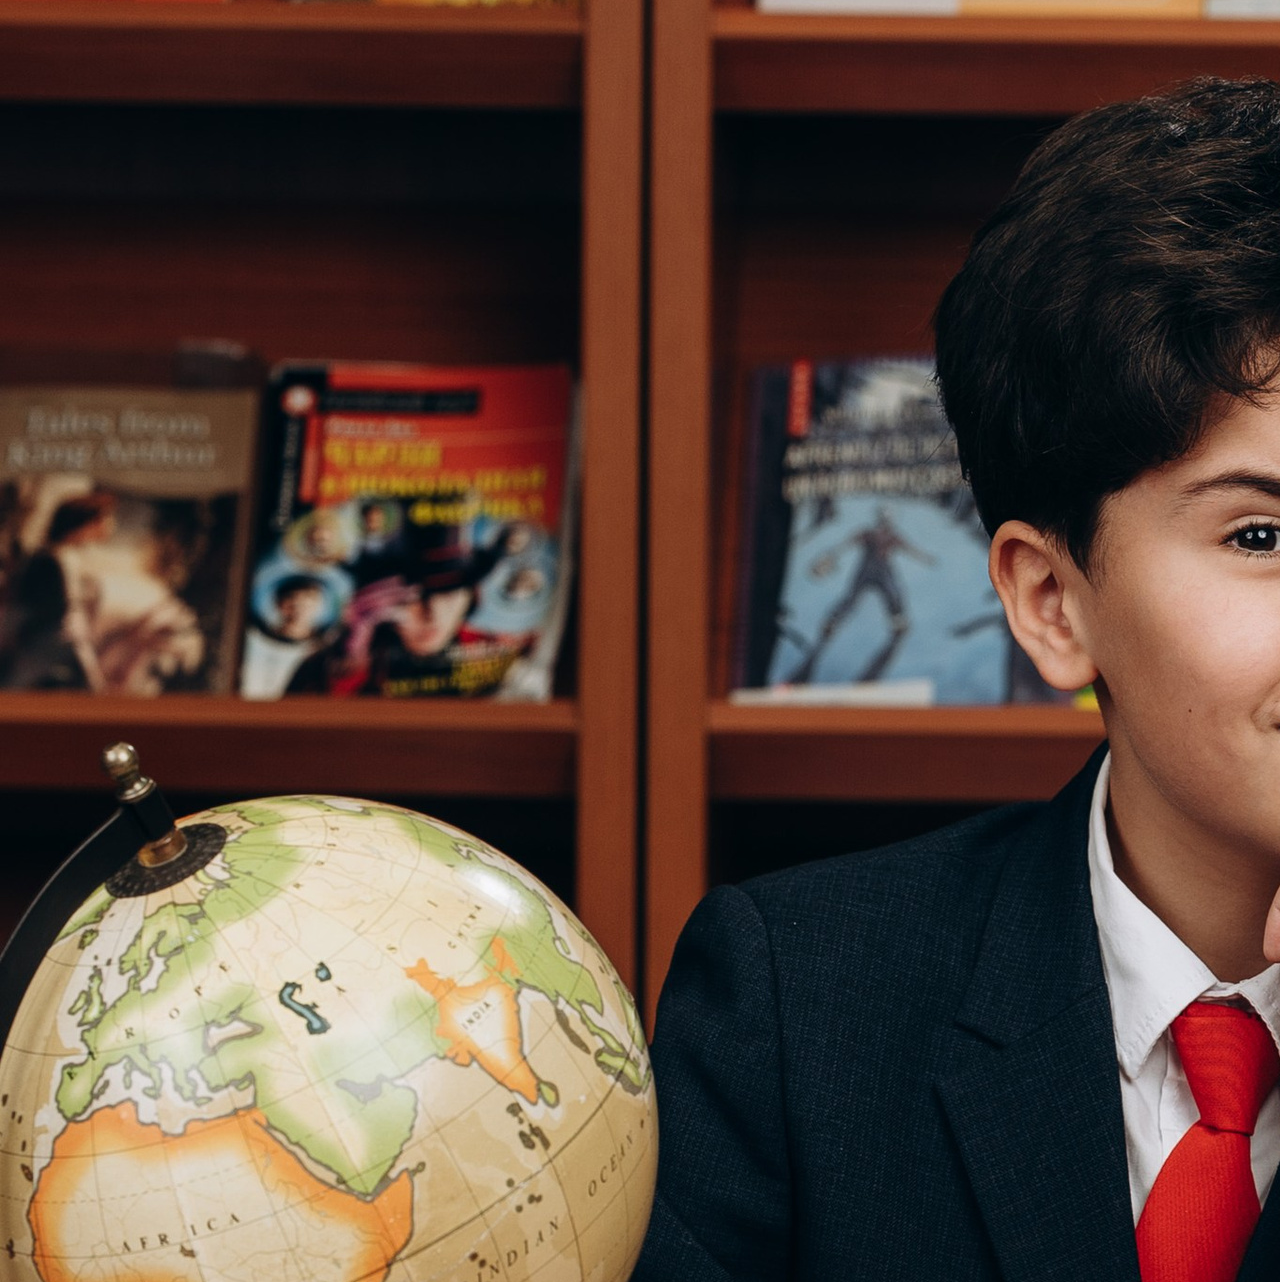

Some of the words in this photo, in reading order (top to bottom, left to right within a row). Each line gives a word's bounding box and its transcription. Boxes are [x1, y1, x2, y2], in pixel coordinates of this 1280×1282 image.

[462, 1001, 491, 1031] INDIA
[588, 1130, 633, 1198] OCEAN
[122, 1212, 240, 1254] AFRICA
